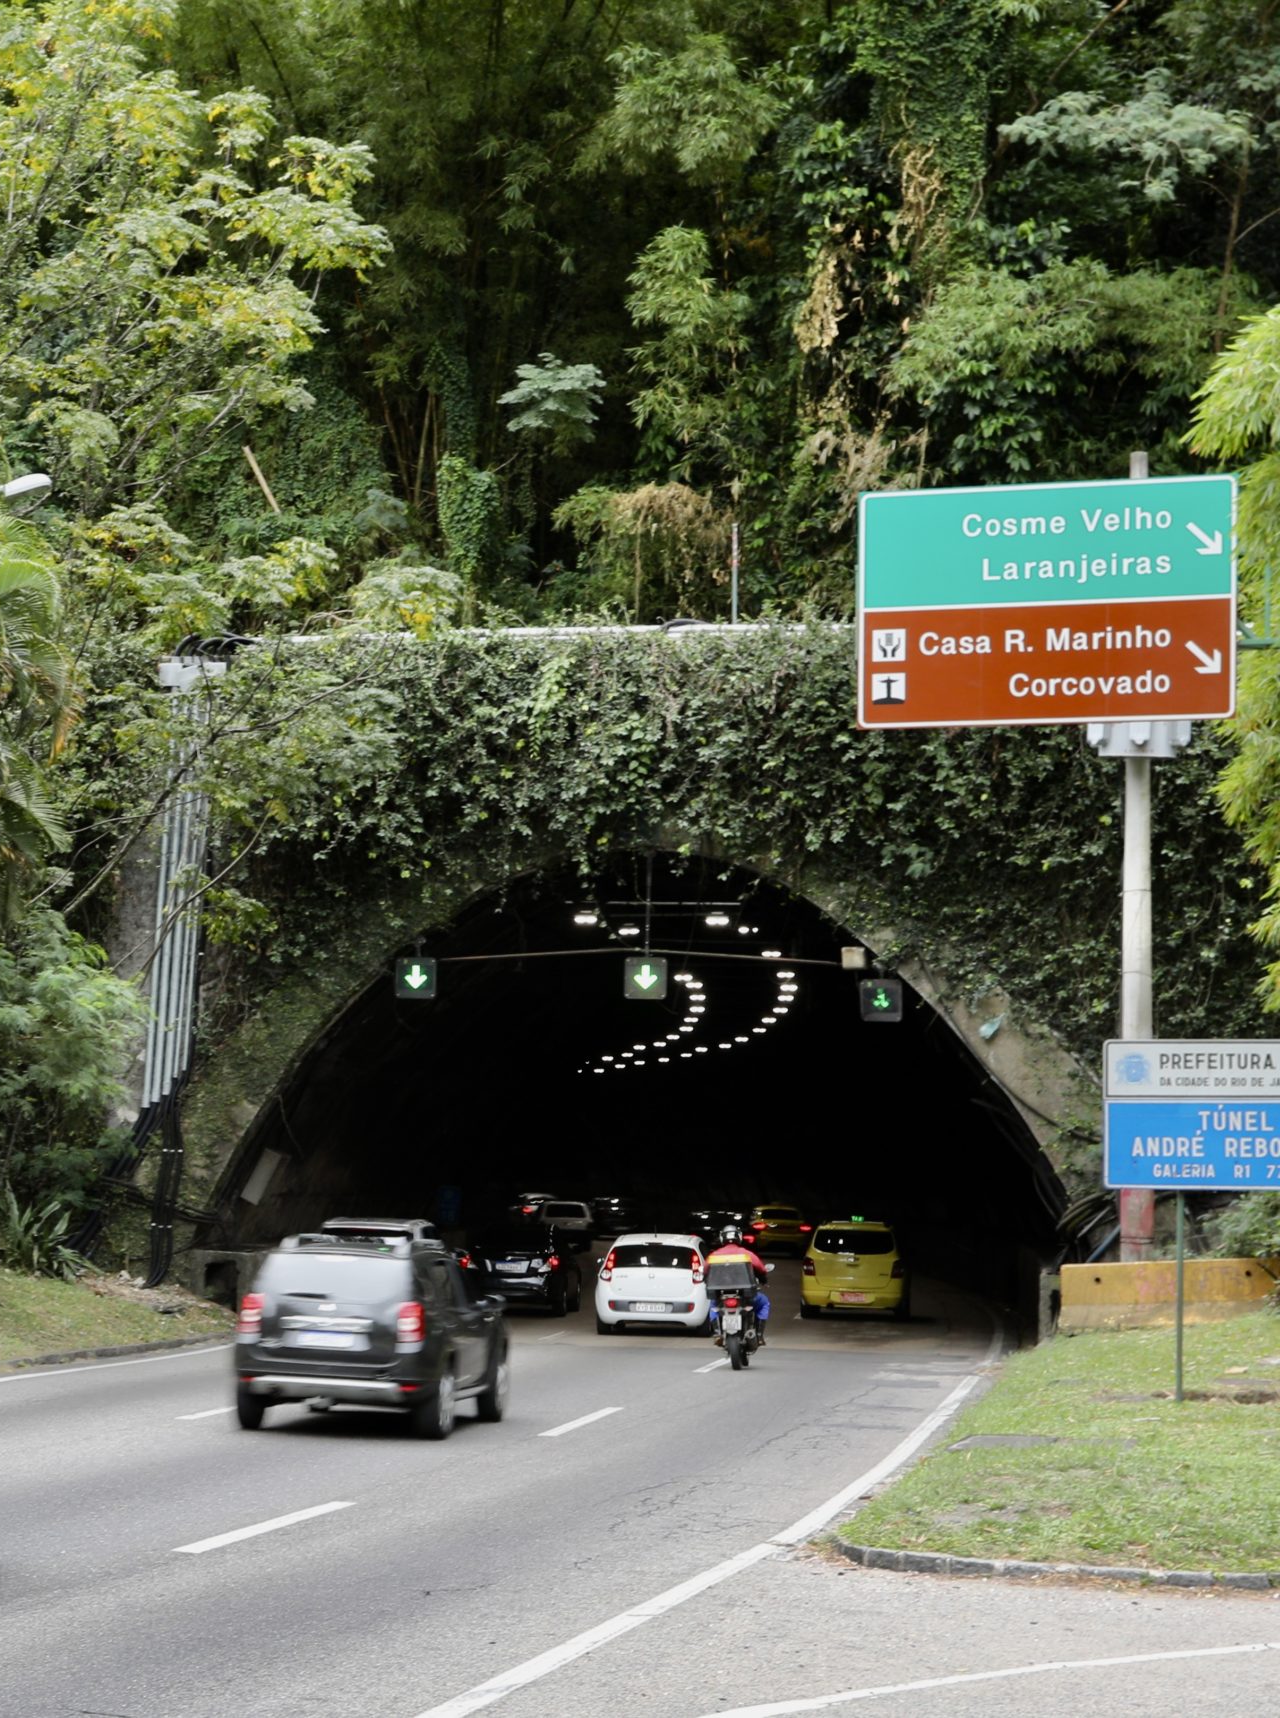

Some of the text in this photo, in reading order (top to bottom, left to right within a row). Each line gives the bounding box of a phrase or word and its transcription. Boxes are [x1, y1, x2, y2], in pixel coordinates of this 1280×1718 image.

[962, 507, 1172, 538] Cosme Velho
[981, 553, 1172, 584] Laranjeiras
[918, 625, 1172, 656] Casa R. Marinho
[1008, 670, 1171, 698] Corcovado
[1159, 1053, 1276, 1070] PREFEITURA
[1159, 1077, 1172, 1087] DA
[1175, 1077, 1209, 1087] CIDADE
[1214, 1077, 1227, 1087] DO
[1230, 1077, 1247, 1087] RIO
[1251, 1077, 1265, 1087] DE
[1198, 1104, 1274, 1132] TÚNEL
[1131, 1130, 1280, 1158] ANDRÉ REBO
[1152, 1163, 1216, 1178] GALERIA
[1233, 1164, 1251, 1179] R1
